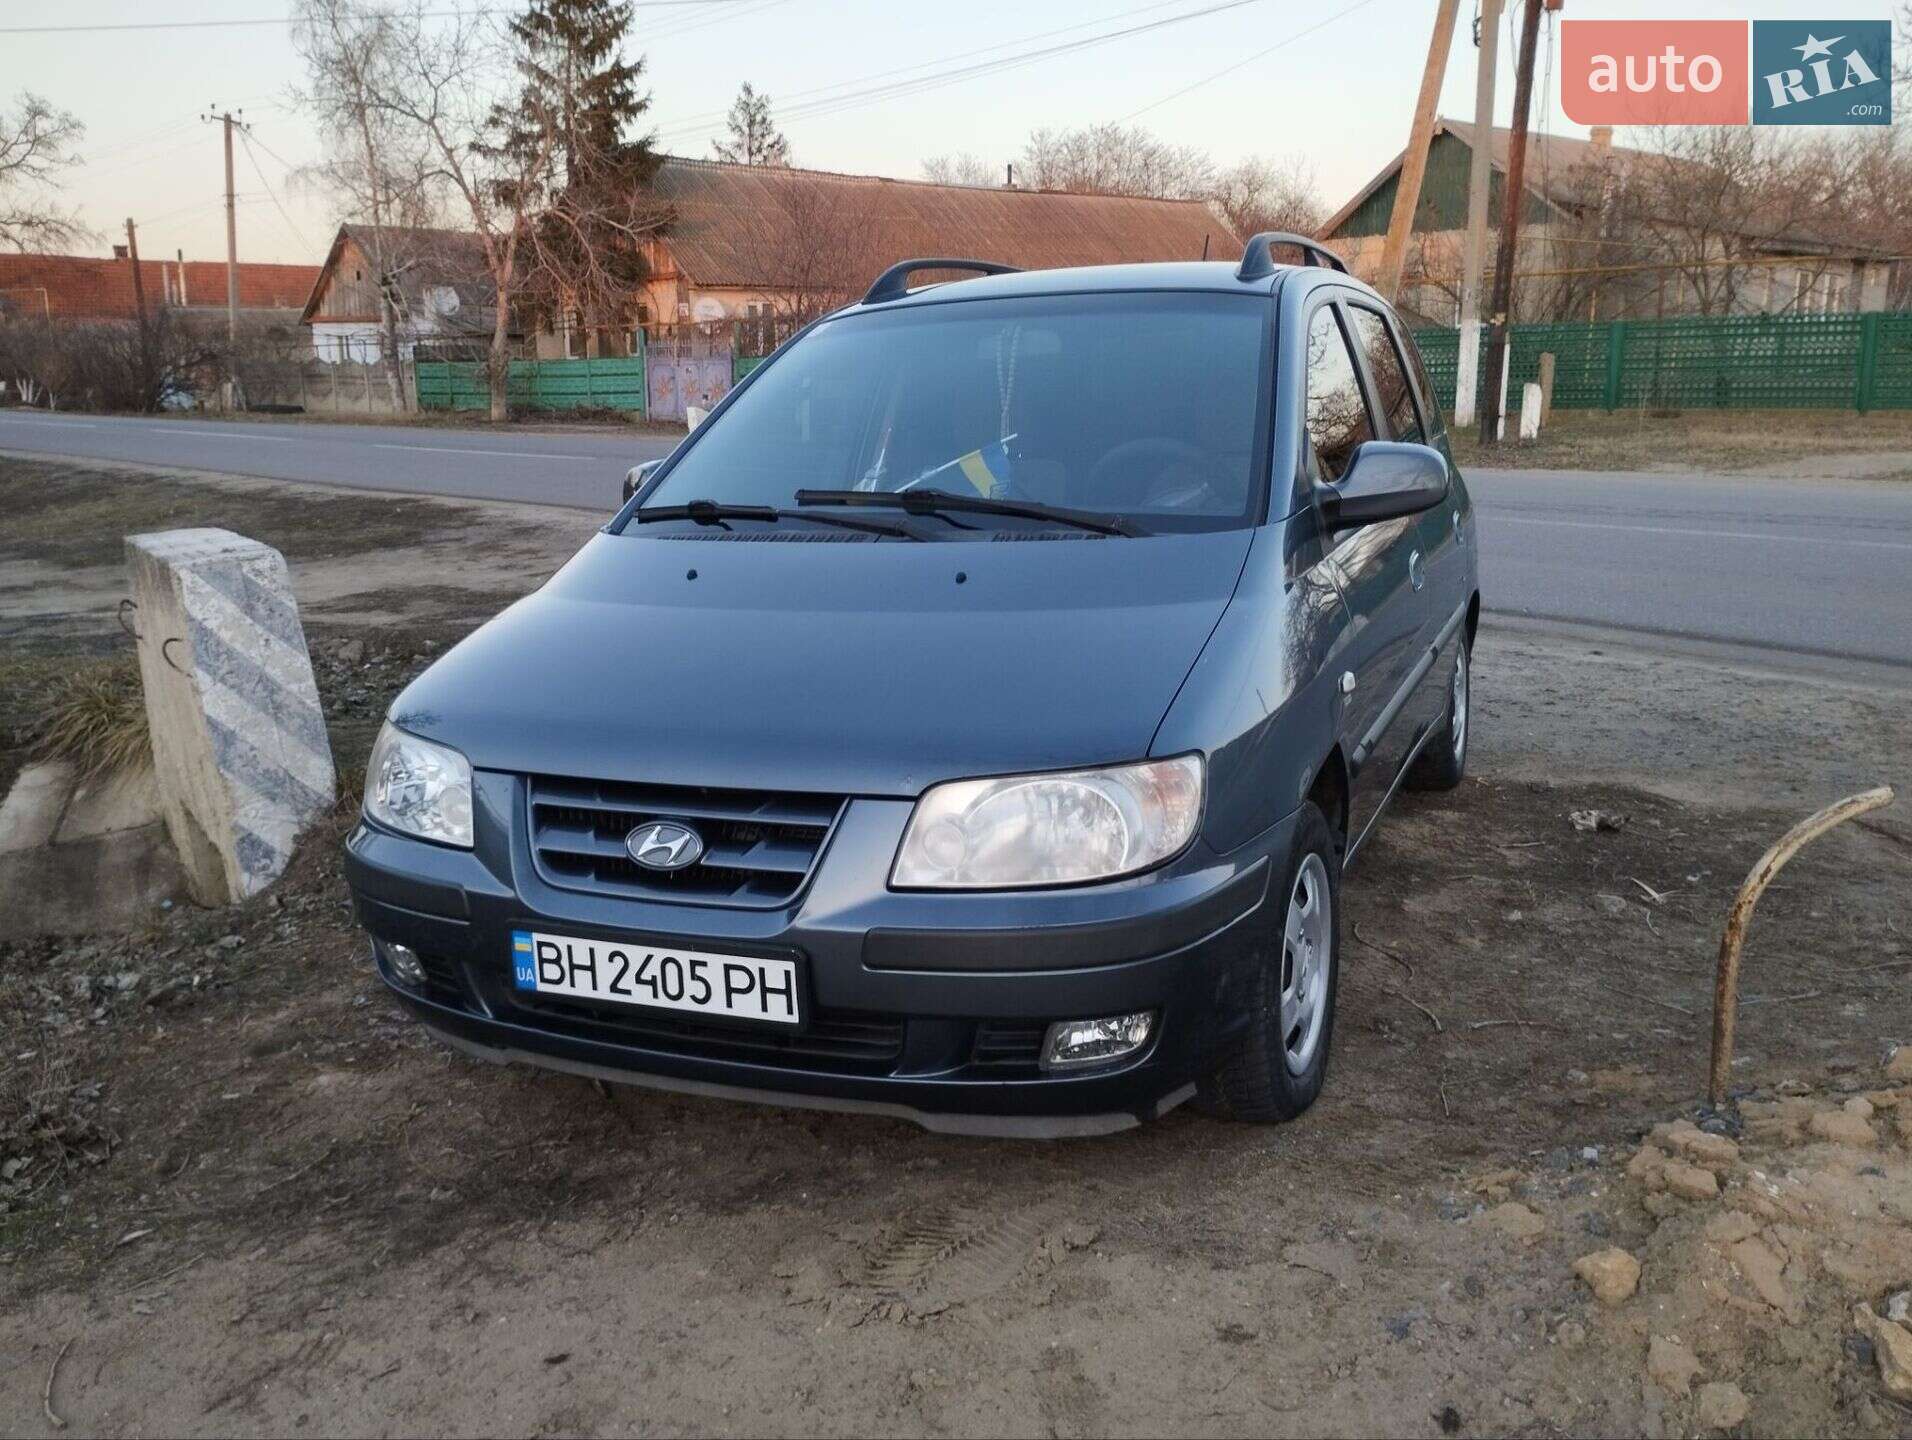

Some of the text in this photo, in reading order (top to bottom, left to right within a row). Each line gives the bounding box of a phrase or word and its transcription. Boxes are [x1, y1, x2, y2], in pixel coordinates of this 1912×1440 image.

[516, 966, 535, 983] UA
[536, 940, 794, 1016] BH 2405 PH
